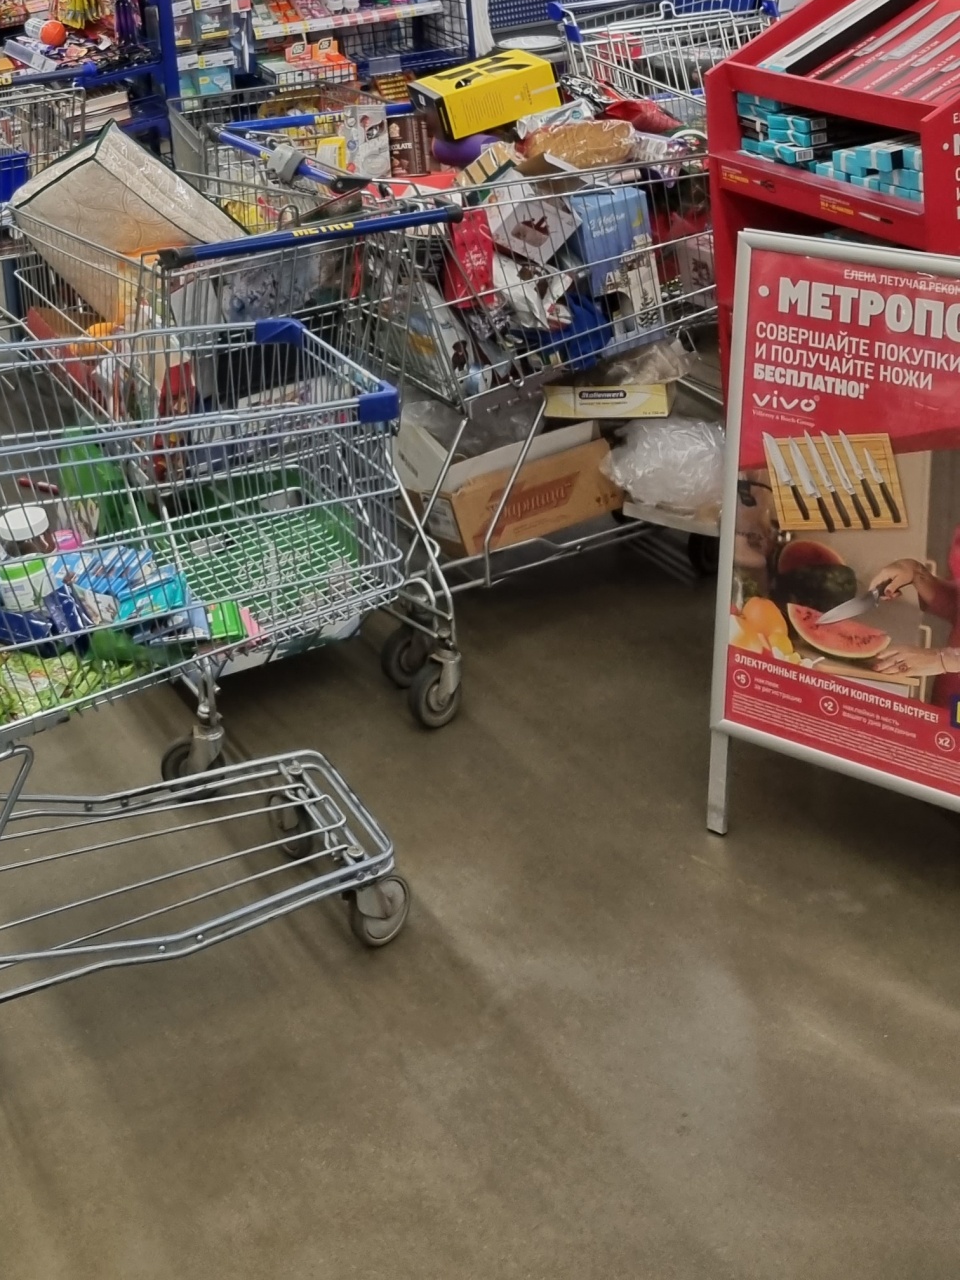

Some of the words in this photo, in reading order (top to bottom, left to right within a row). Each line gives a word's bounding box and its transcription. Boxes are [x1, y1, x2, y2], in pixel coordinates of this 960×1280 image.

[292, 221, 355, 237] METRO
[844, 269, 877, 283] ЕЛЕНА
[879, 274, 927, 291] ЛЕТУЧАЯ
[756, 322, 870, 357] СОВЕРШАЙТЕ
[755, 342, 766, 359] И
[771, 344, 875, 380] ПОЛУЧАЙТЕ
[879, 366, 933, 391] НОЖИ
[752, 390, 817, 413] vivo
[735, 654, 798, 681] ЭЛЕКТРОННЫЕ
[798, 674, 850, 697] НАКЛЕЙКИ
[850, 686, 892, 709] КОПЯТСЯ
[892, 701, 939, 724] БЫСТРЕЕ!
